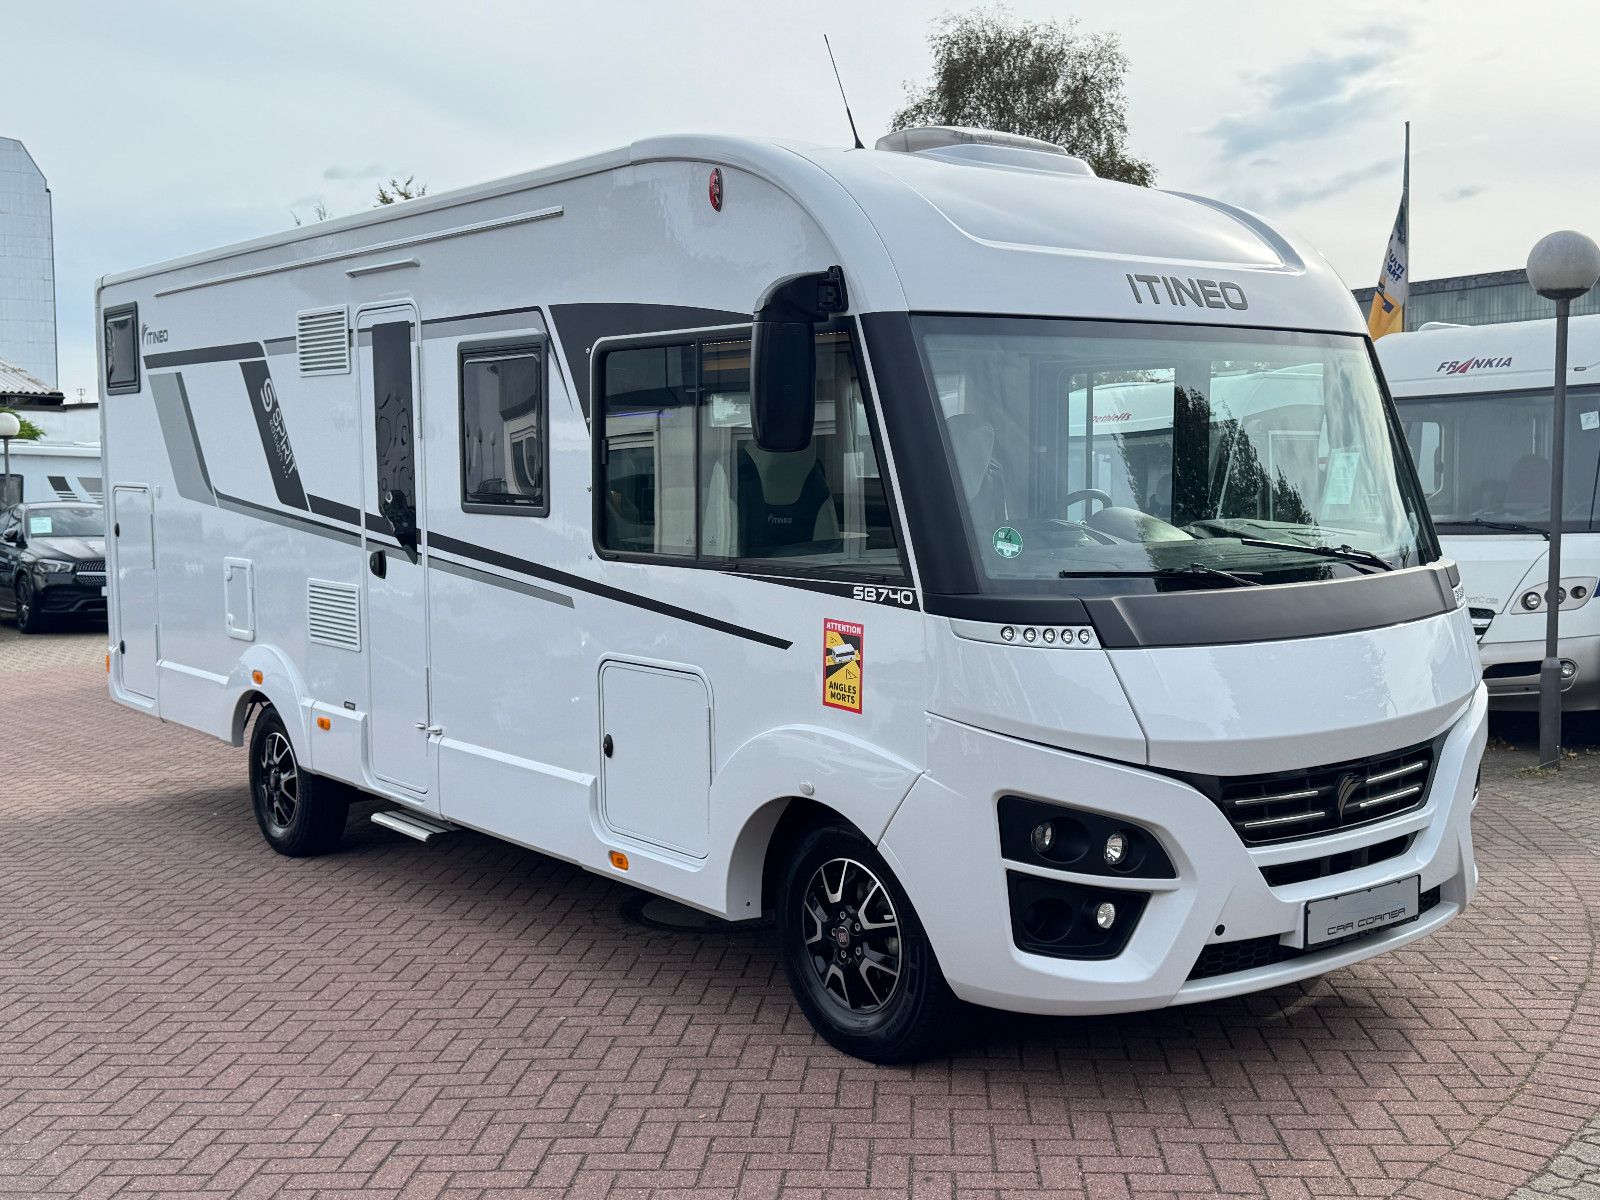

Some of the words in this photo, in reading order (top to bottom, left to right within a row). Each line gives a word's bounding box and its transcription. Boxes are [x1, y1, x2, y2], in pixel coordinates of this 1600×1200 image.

[1126, 273, 1248, 310] ITINEO
[1436, 357, 1512, 375] FRANKIA
[273, 407, 298, 474] SPIRIT
[853, 586, 914, 605] SB740
[826, 621, 862, 635] ATTENTION
[828, 681, 857, 695] ANGLES
[830, 691, 856, 704] MORTS
[1327, 921, 1354, 936] CAR
[1357, 907, 1406, 928] CORNER
